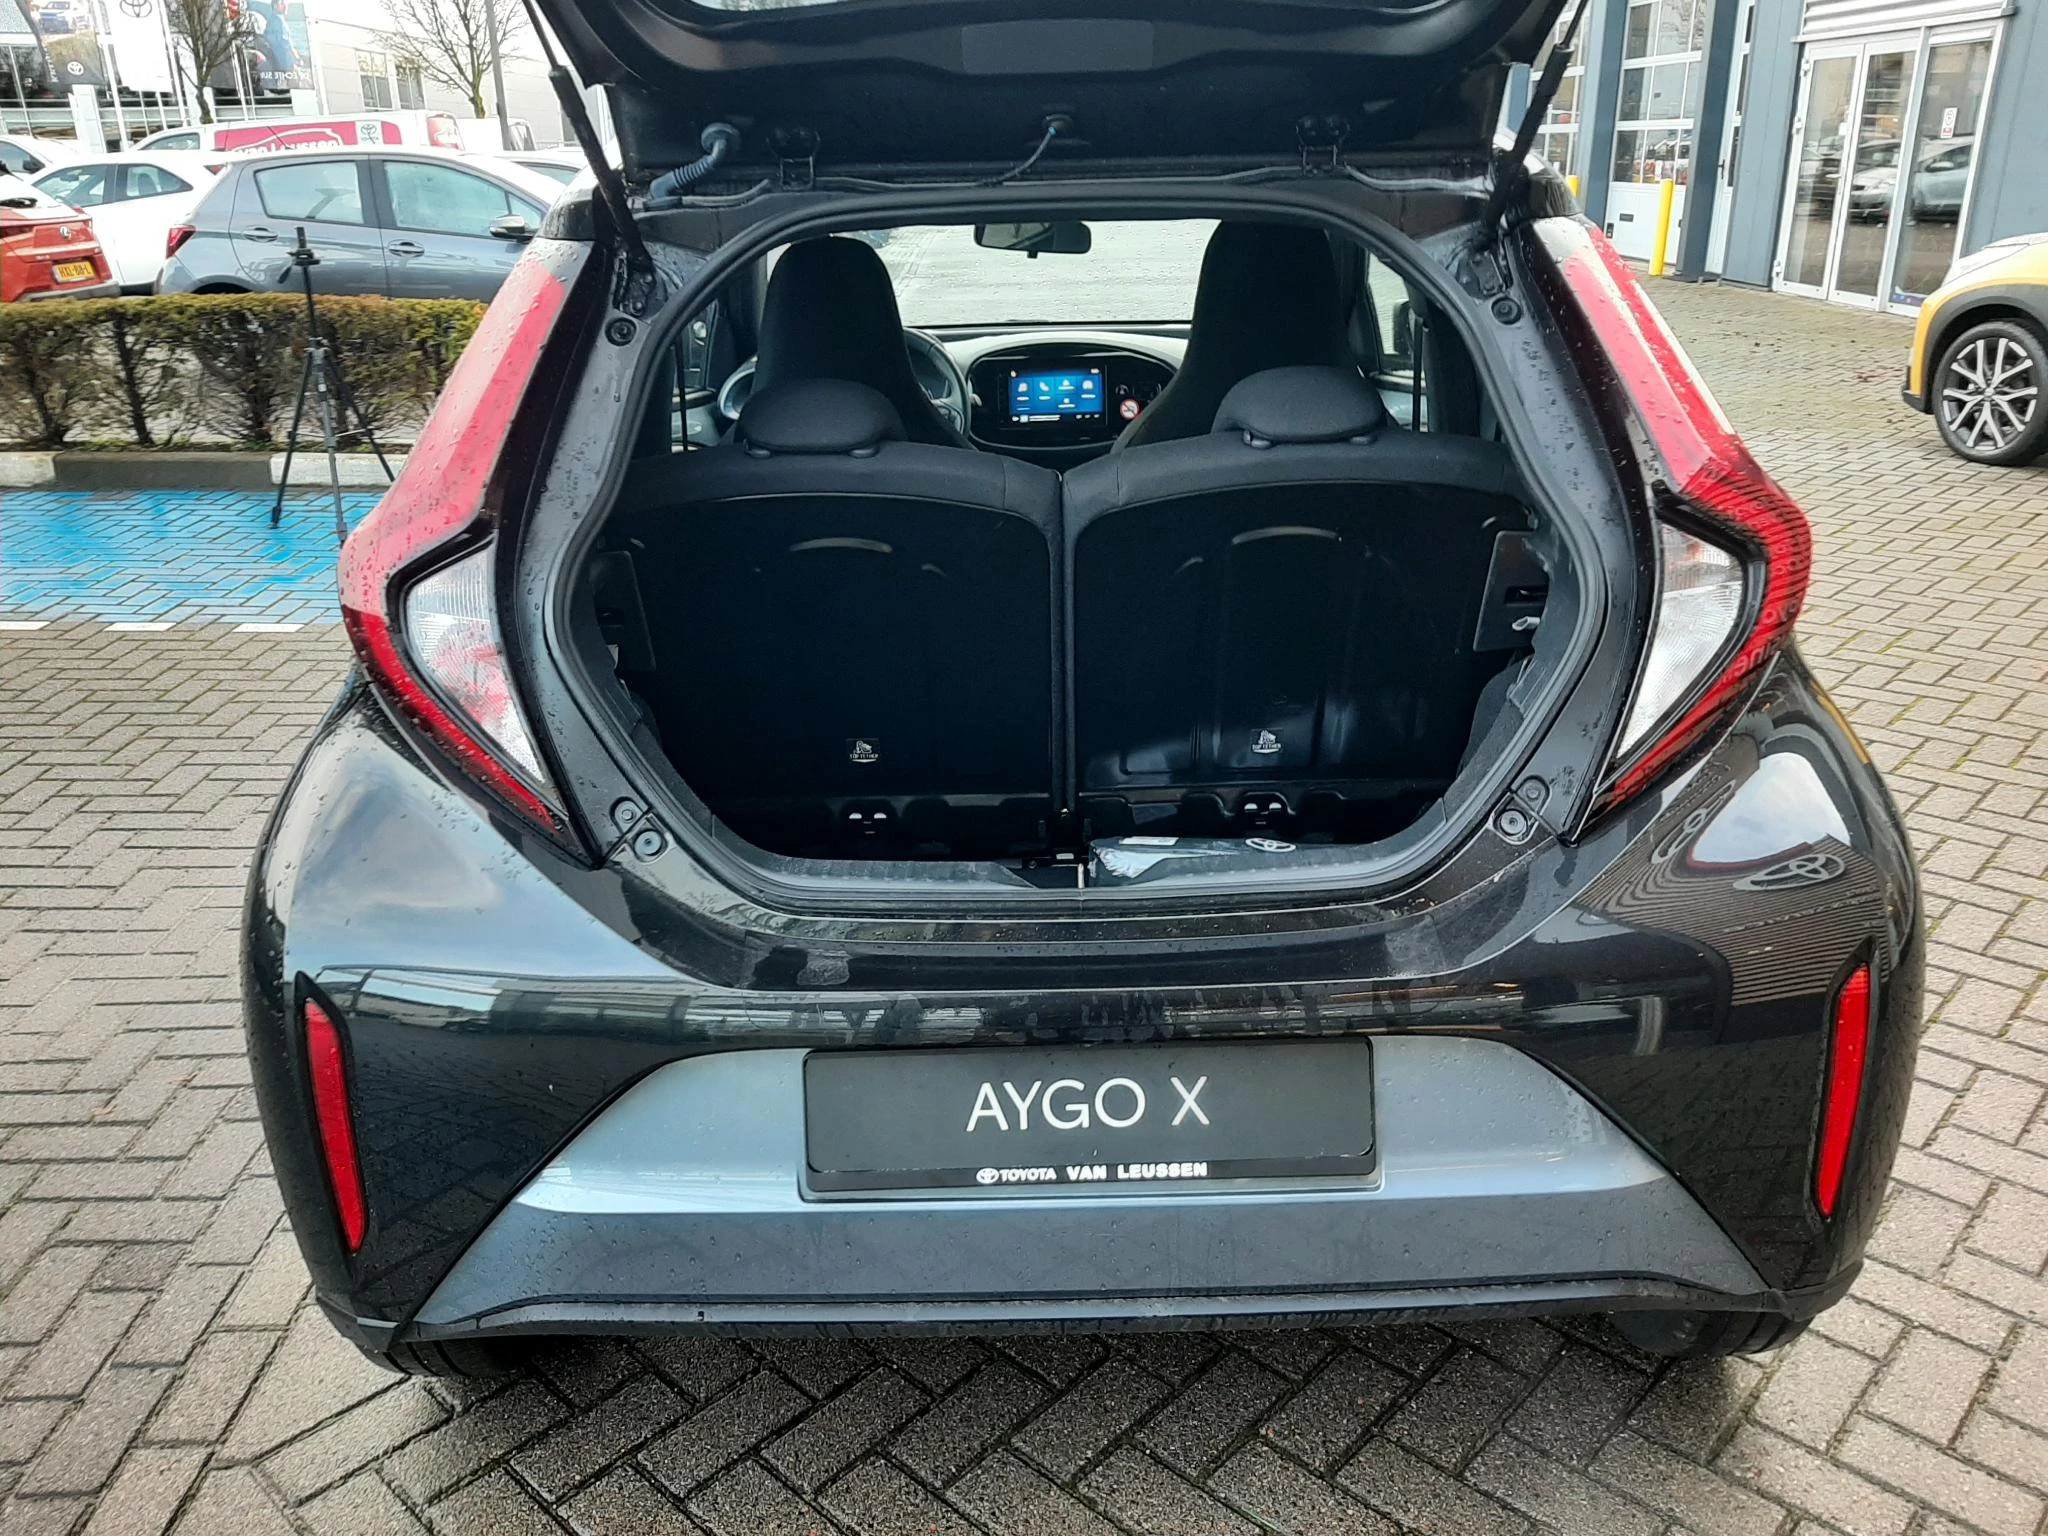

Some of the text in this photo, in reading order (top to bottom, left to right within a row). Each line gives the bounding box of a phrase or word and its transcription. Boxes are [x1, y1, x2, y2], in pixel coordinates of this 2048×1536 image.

[966, 1076, 1210, 1132] AYGO X
[1000, 1162, 1208, 1182] TOYOTA VAN LEUSSEN
